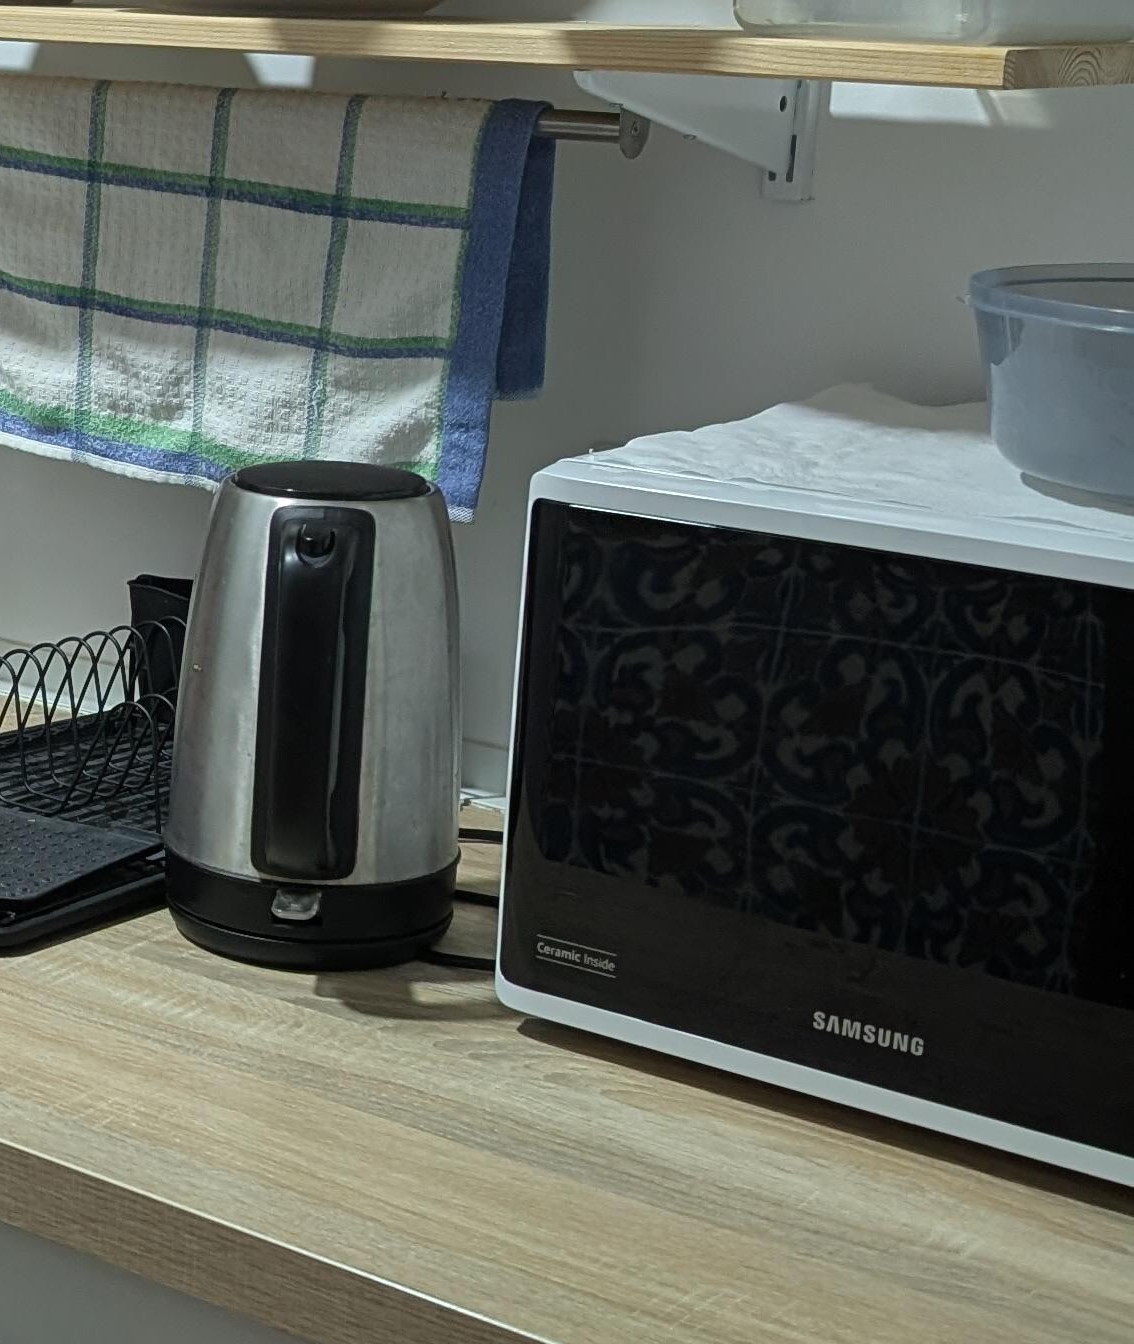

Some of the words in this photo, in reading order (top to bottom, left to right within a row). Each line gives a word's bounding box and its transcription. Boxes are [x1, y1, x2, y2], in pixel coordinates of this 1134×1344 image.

[536, 942, 581, 963] Ceramic
[583, 953, 616, 972] Inside
[812, 1011, 924, 1056] SAMSUNG
